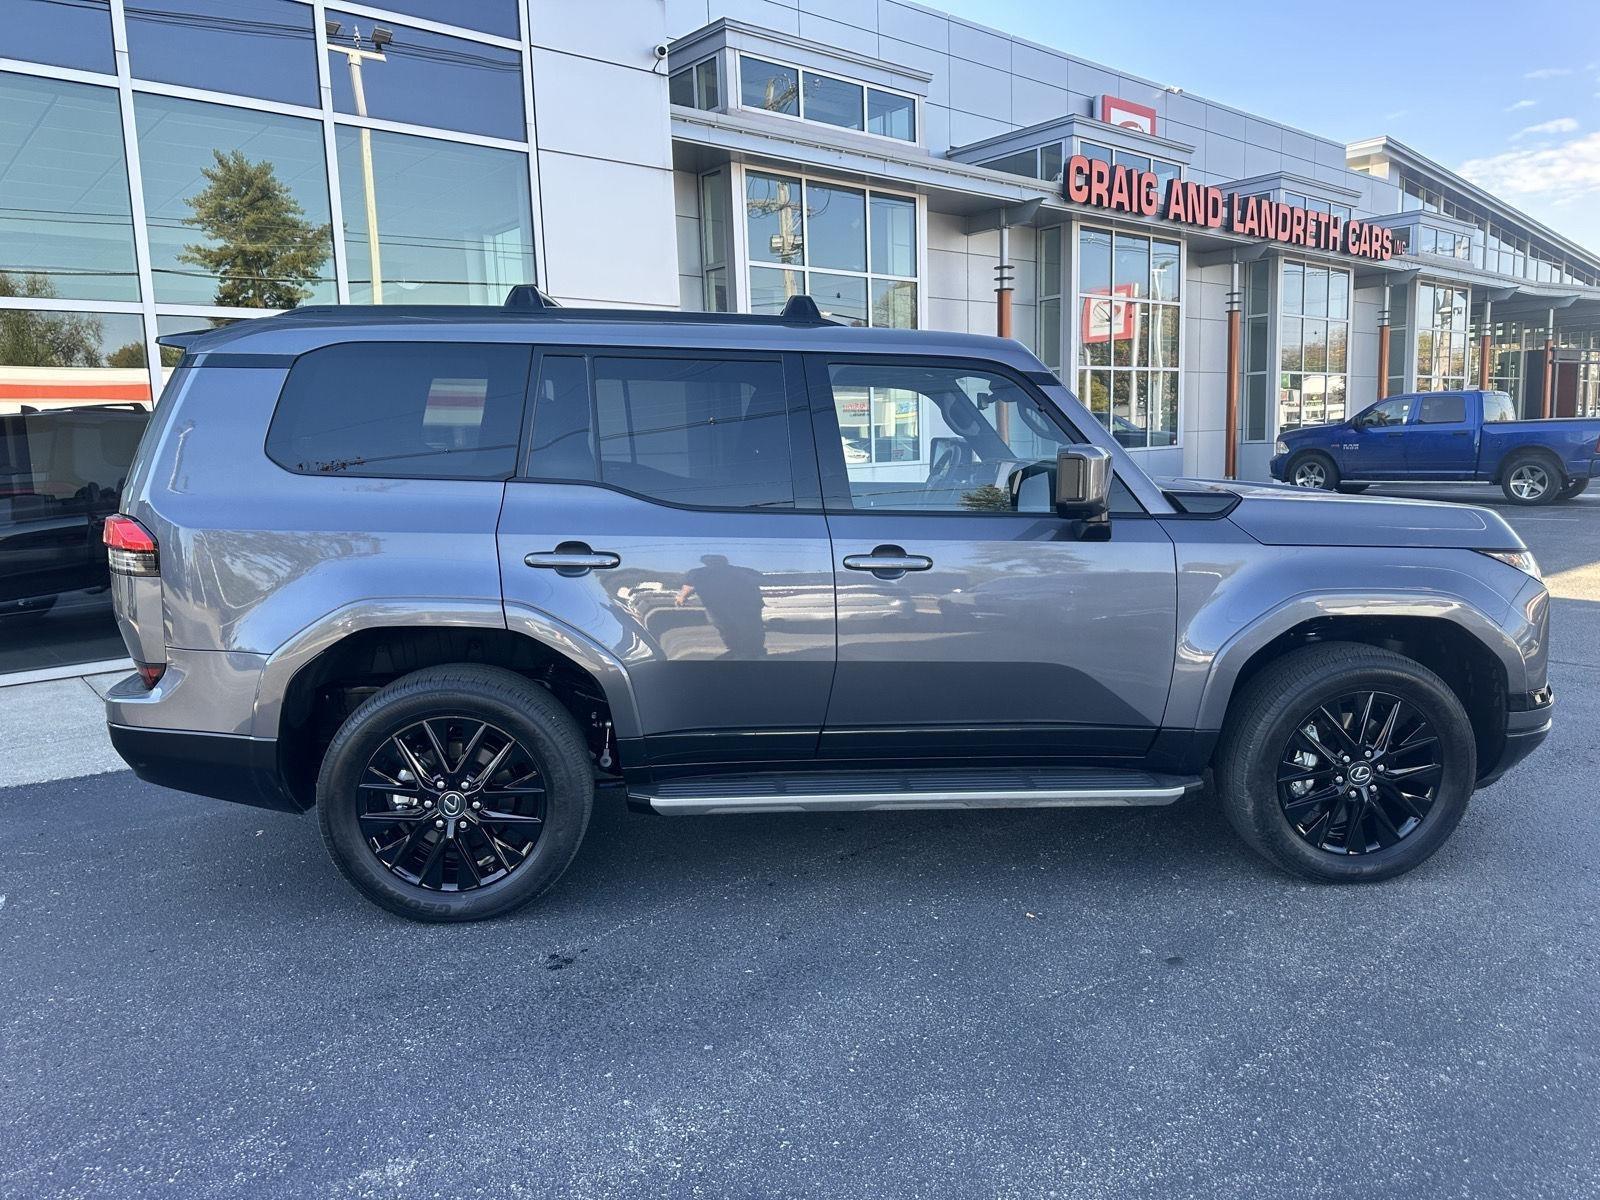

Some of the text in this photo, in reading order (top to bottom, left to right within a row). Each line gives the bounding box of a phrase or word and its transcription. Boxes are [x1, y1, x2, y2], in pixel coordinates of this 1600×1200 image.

[1068, 154, 1159, 216] CRAIG
[1168, 178, 1224, 228] AND
[1232, 192, 1342, 251] LANDRETH
[1348, 219, 1393, 261] CARS
